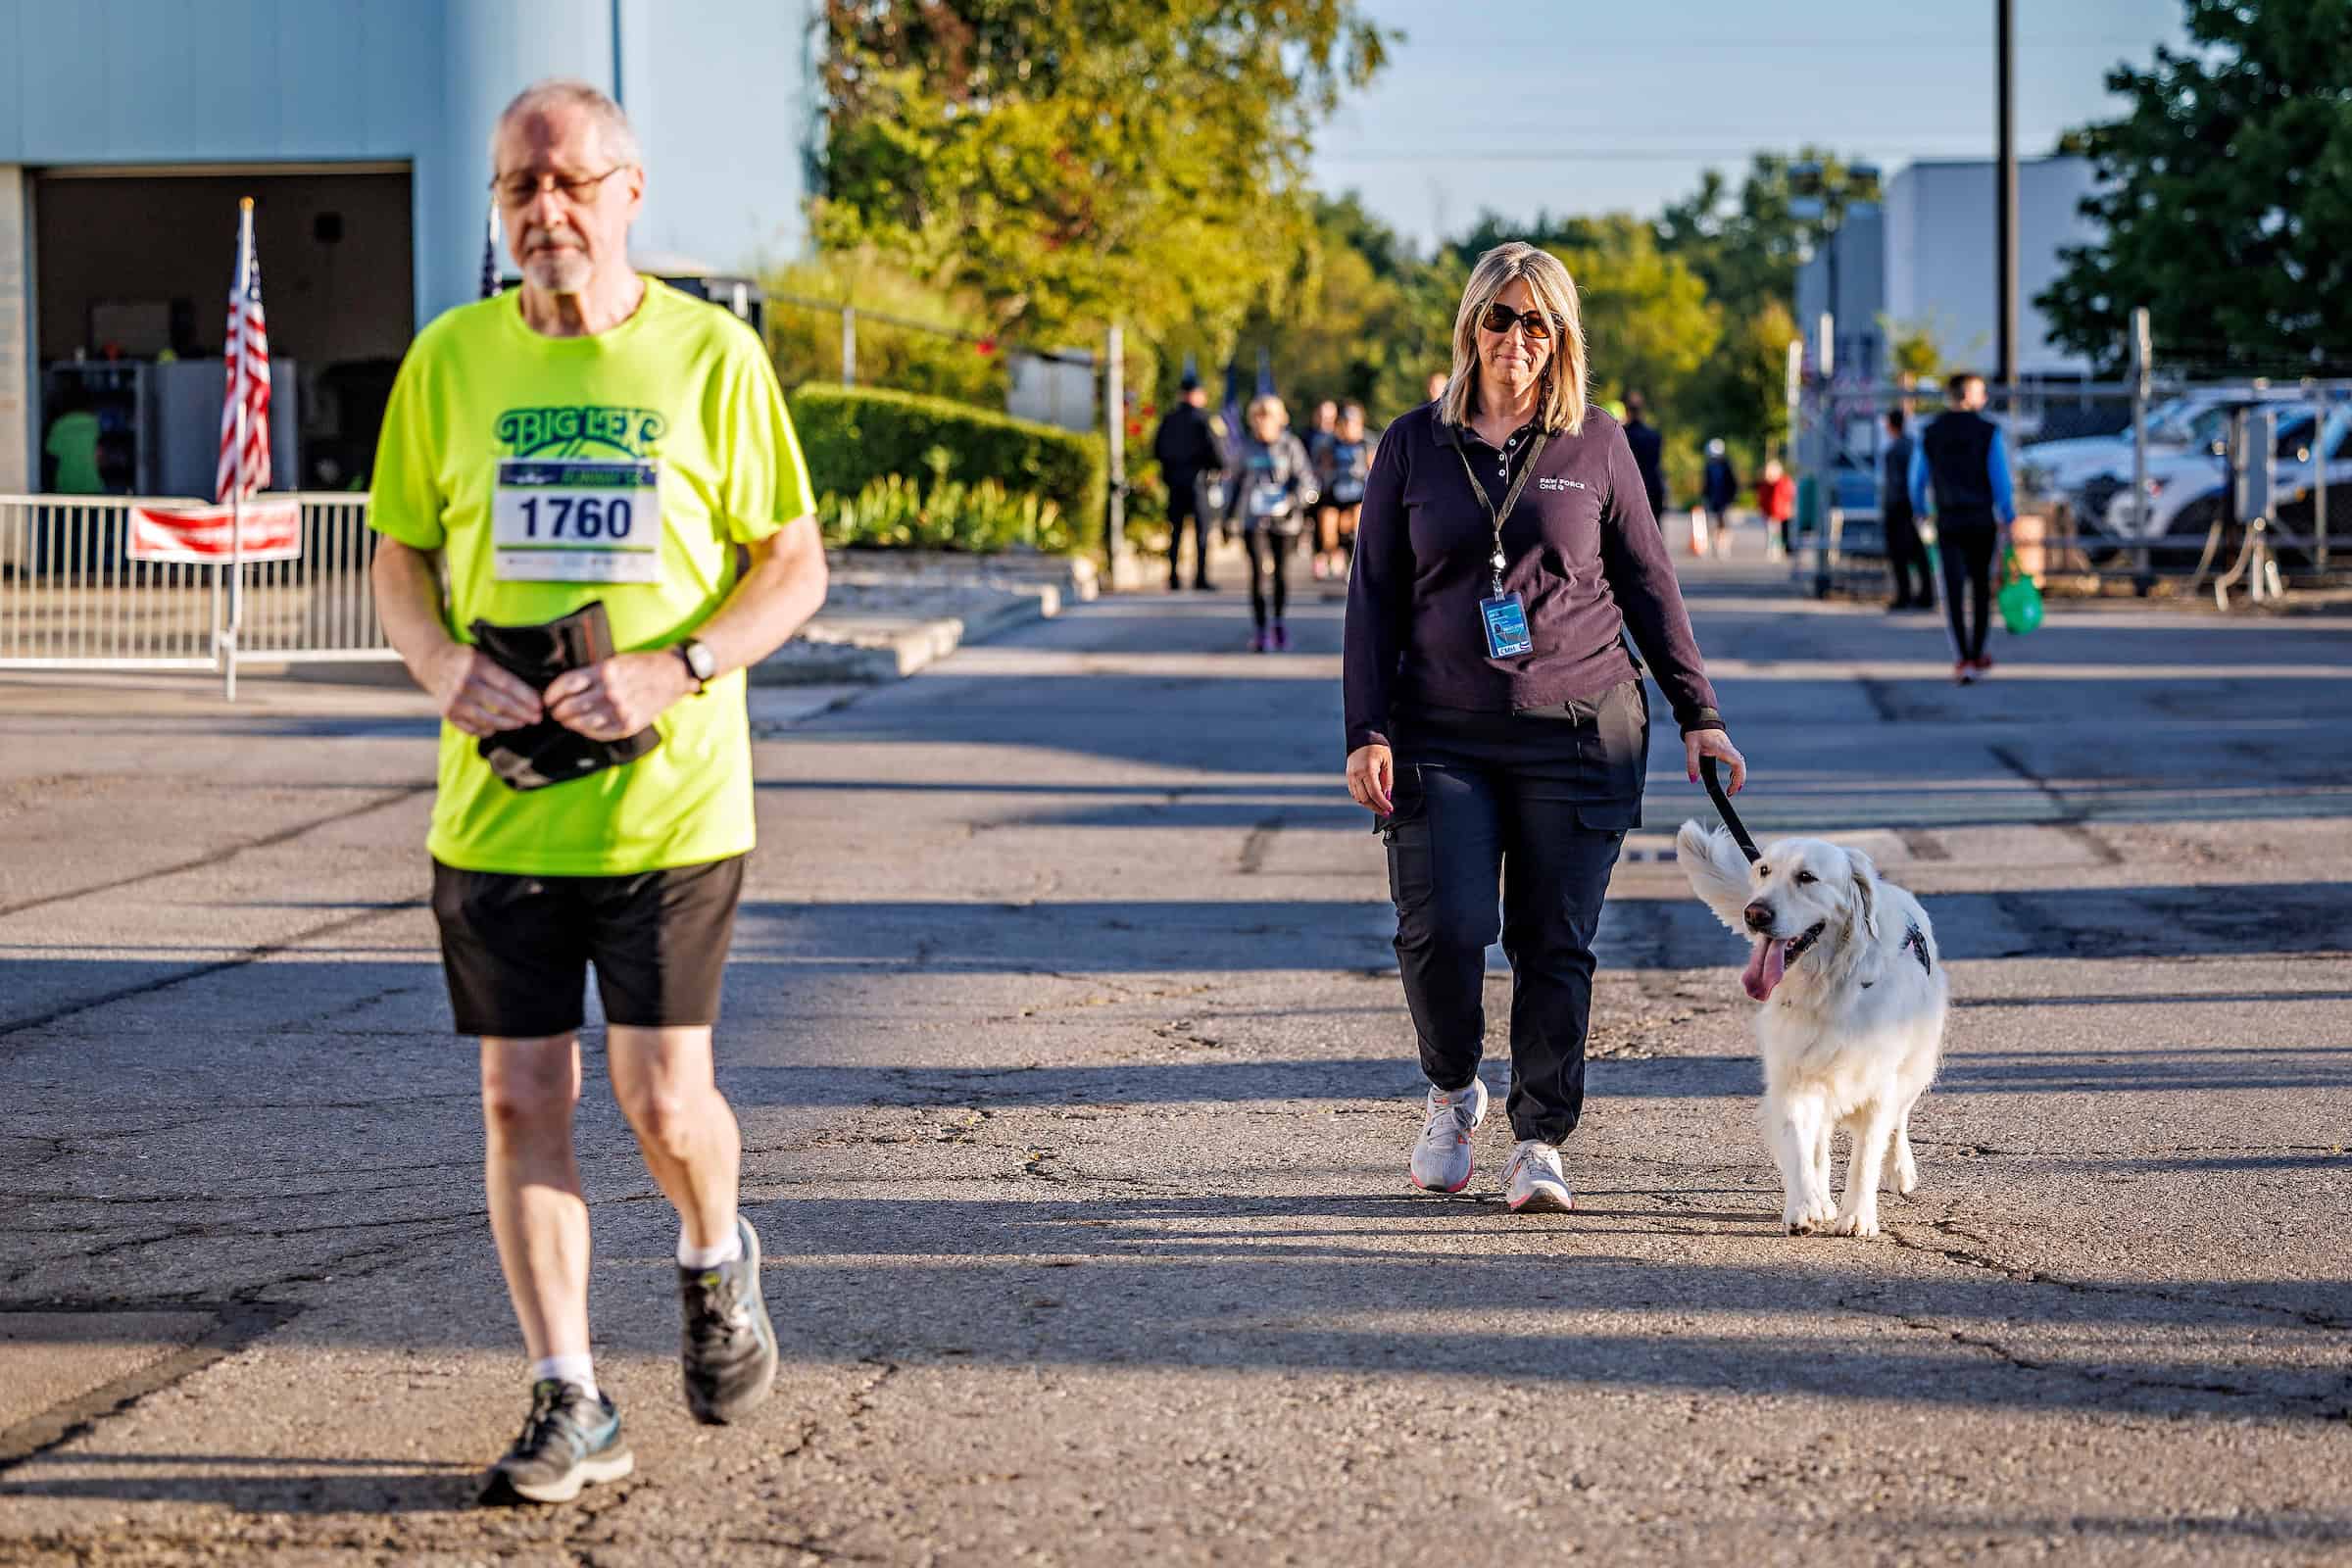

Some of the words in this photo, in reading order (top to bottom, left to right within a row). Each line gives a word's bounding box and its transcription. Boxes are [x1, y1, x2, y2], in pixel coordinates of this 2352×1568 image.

[495, 408, 580, 458] BIG
[1559, 478, 1585, 489] FORCE
[519, 497, 631, 538] 1760
